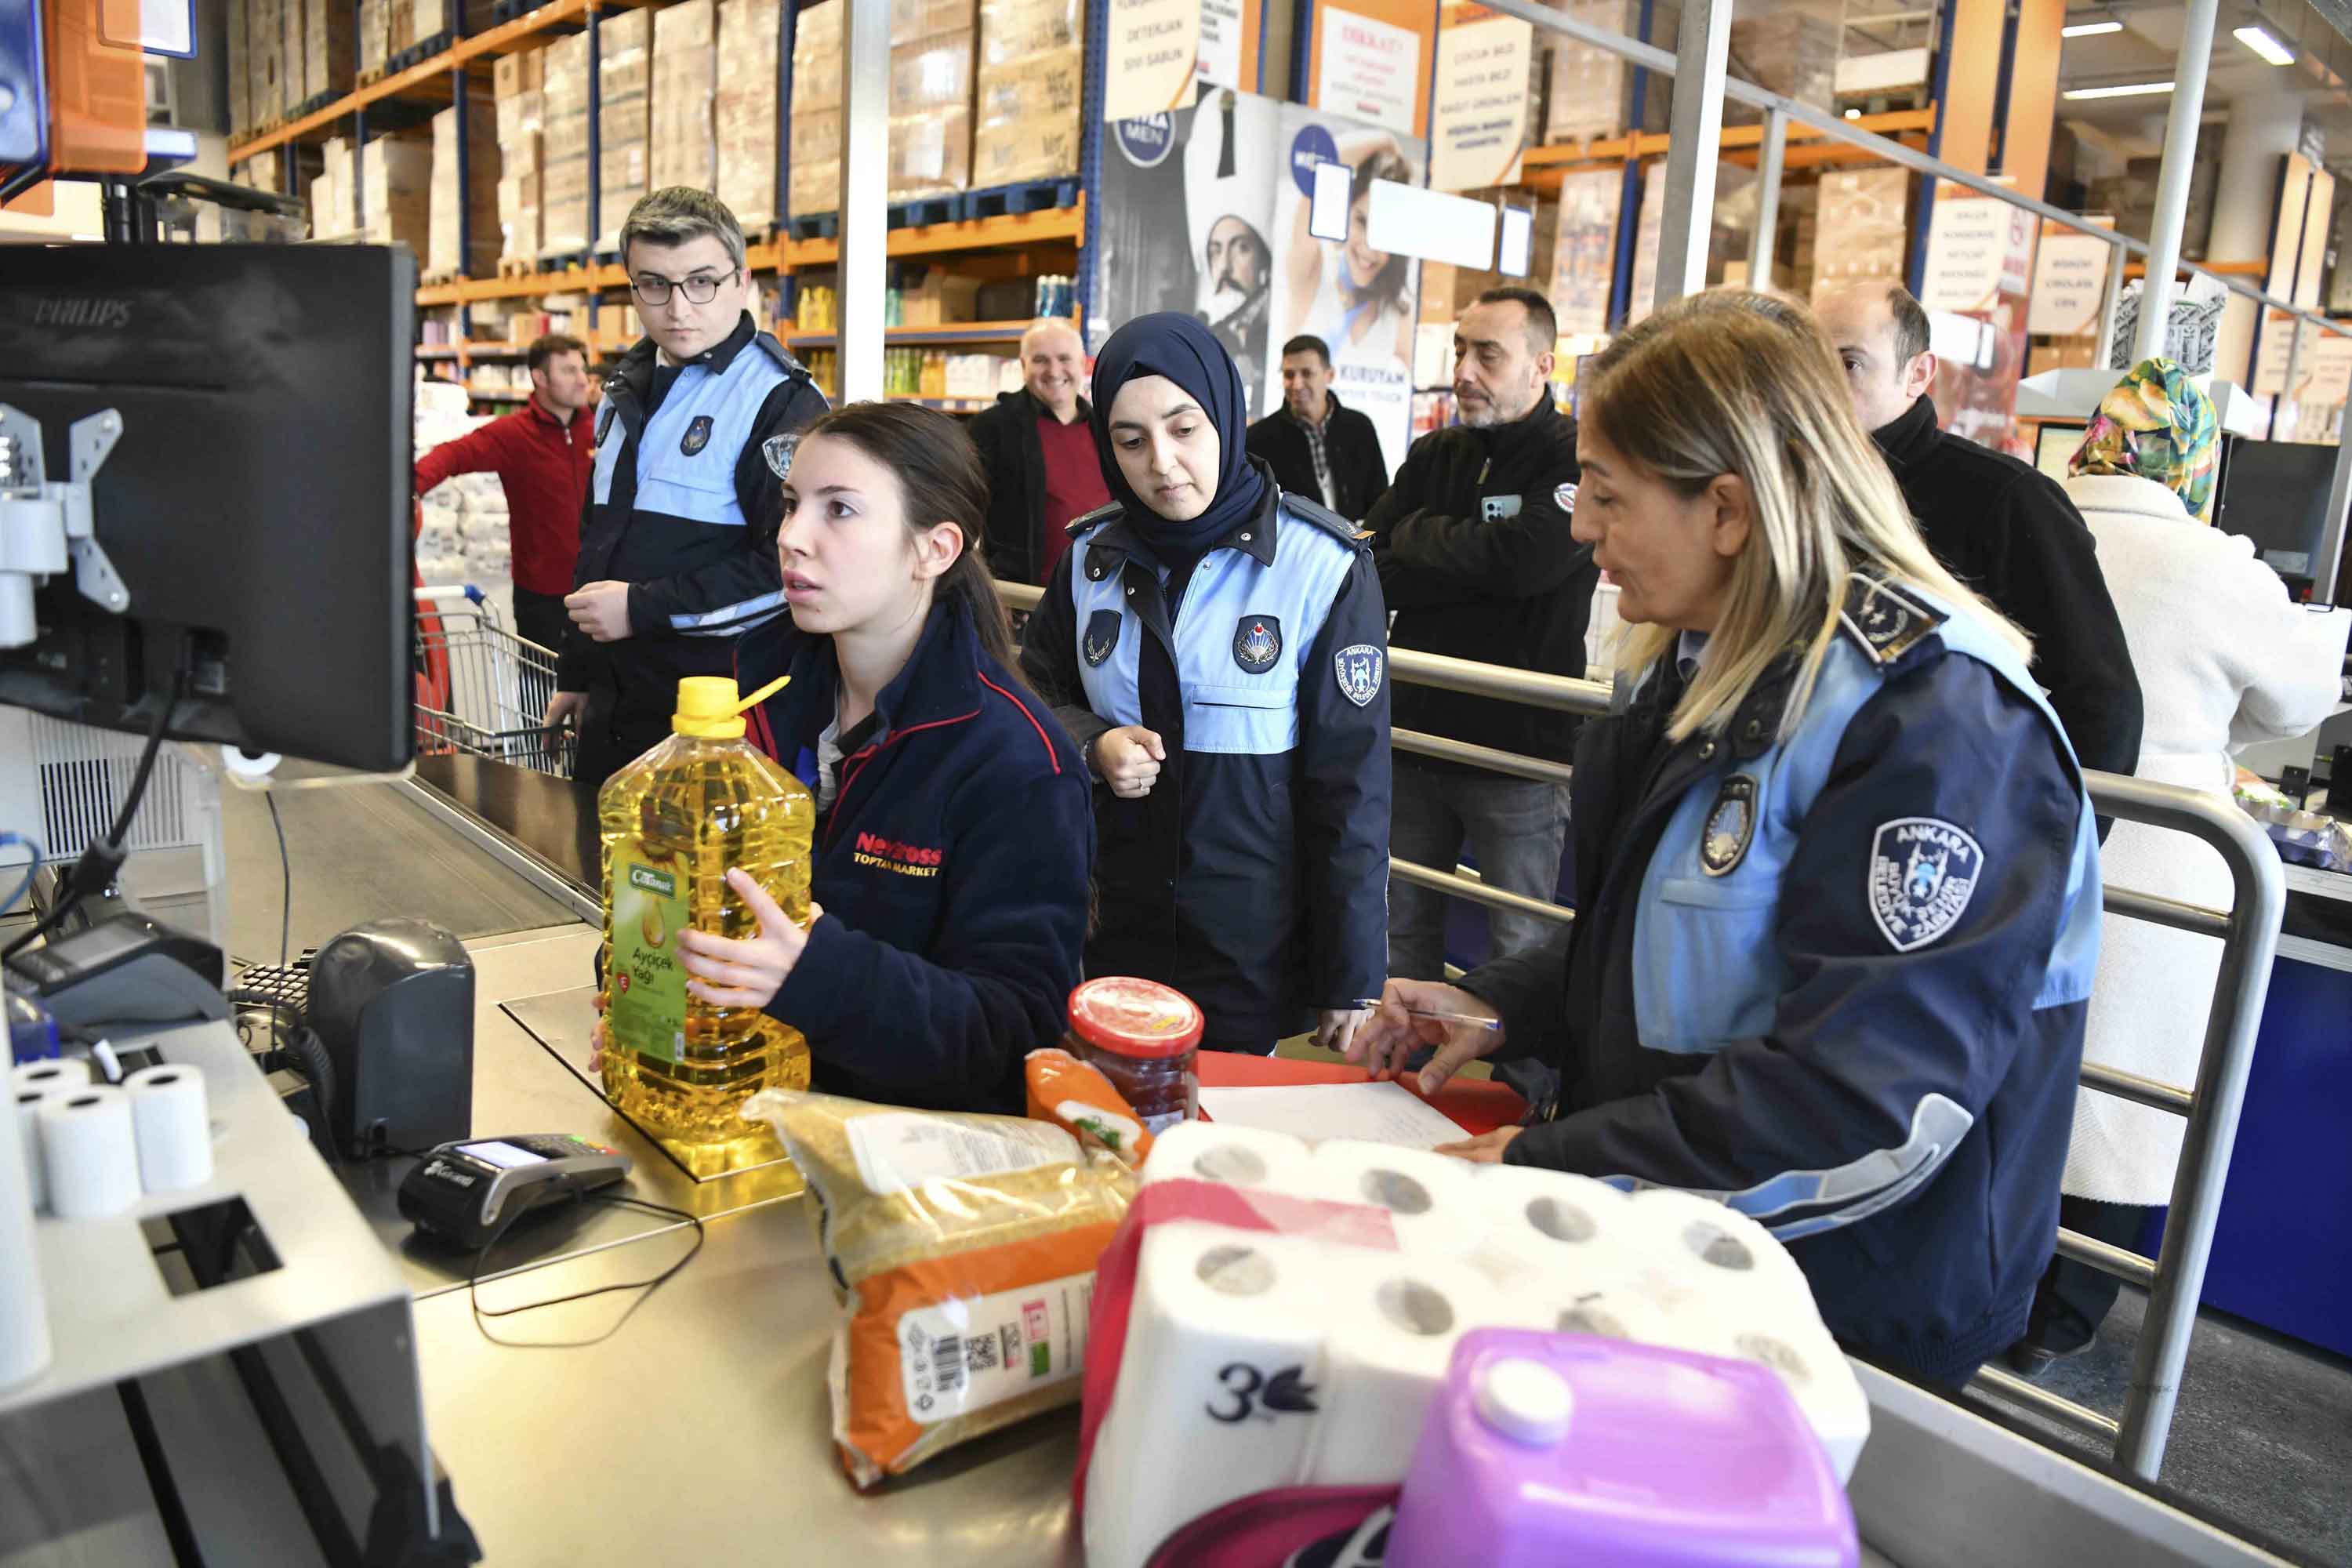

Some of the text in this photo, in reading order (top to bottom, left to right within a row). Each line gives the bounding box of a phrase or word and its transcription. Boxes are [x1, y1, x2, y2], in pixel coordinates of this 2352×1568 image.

[1126, 123, 1164, 145] MEN
[34, 298, 135, 328] PHILIPS
[1346, 646, 1374, 657] ANKARA
[1896, 825, 1969, 864] ANKARA
[892, 863, 939, 877] MARKET
[1206, 1362, 1262, 1425] 3
